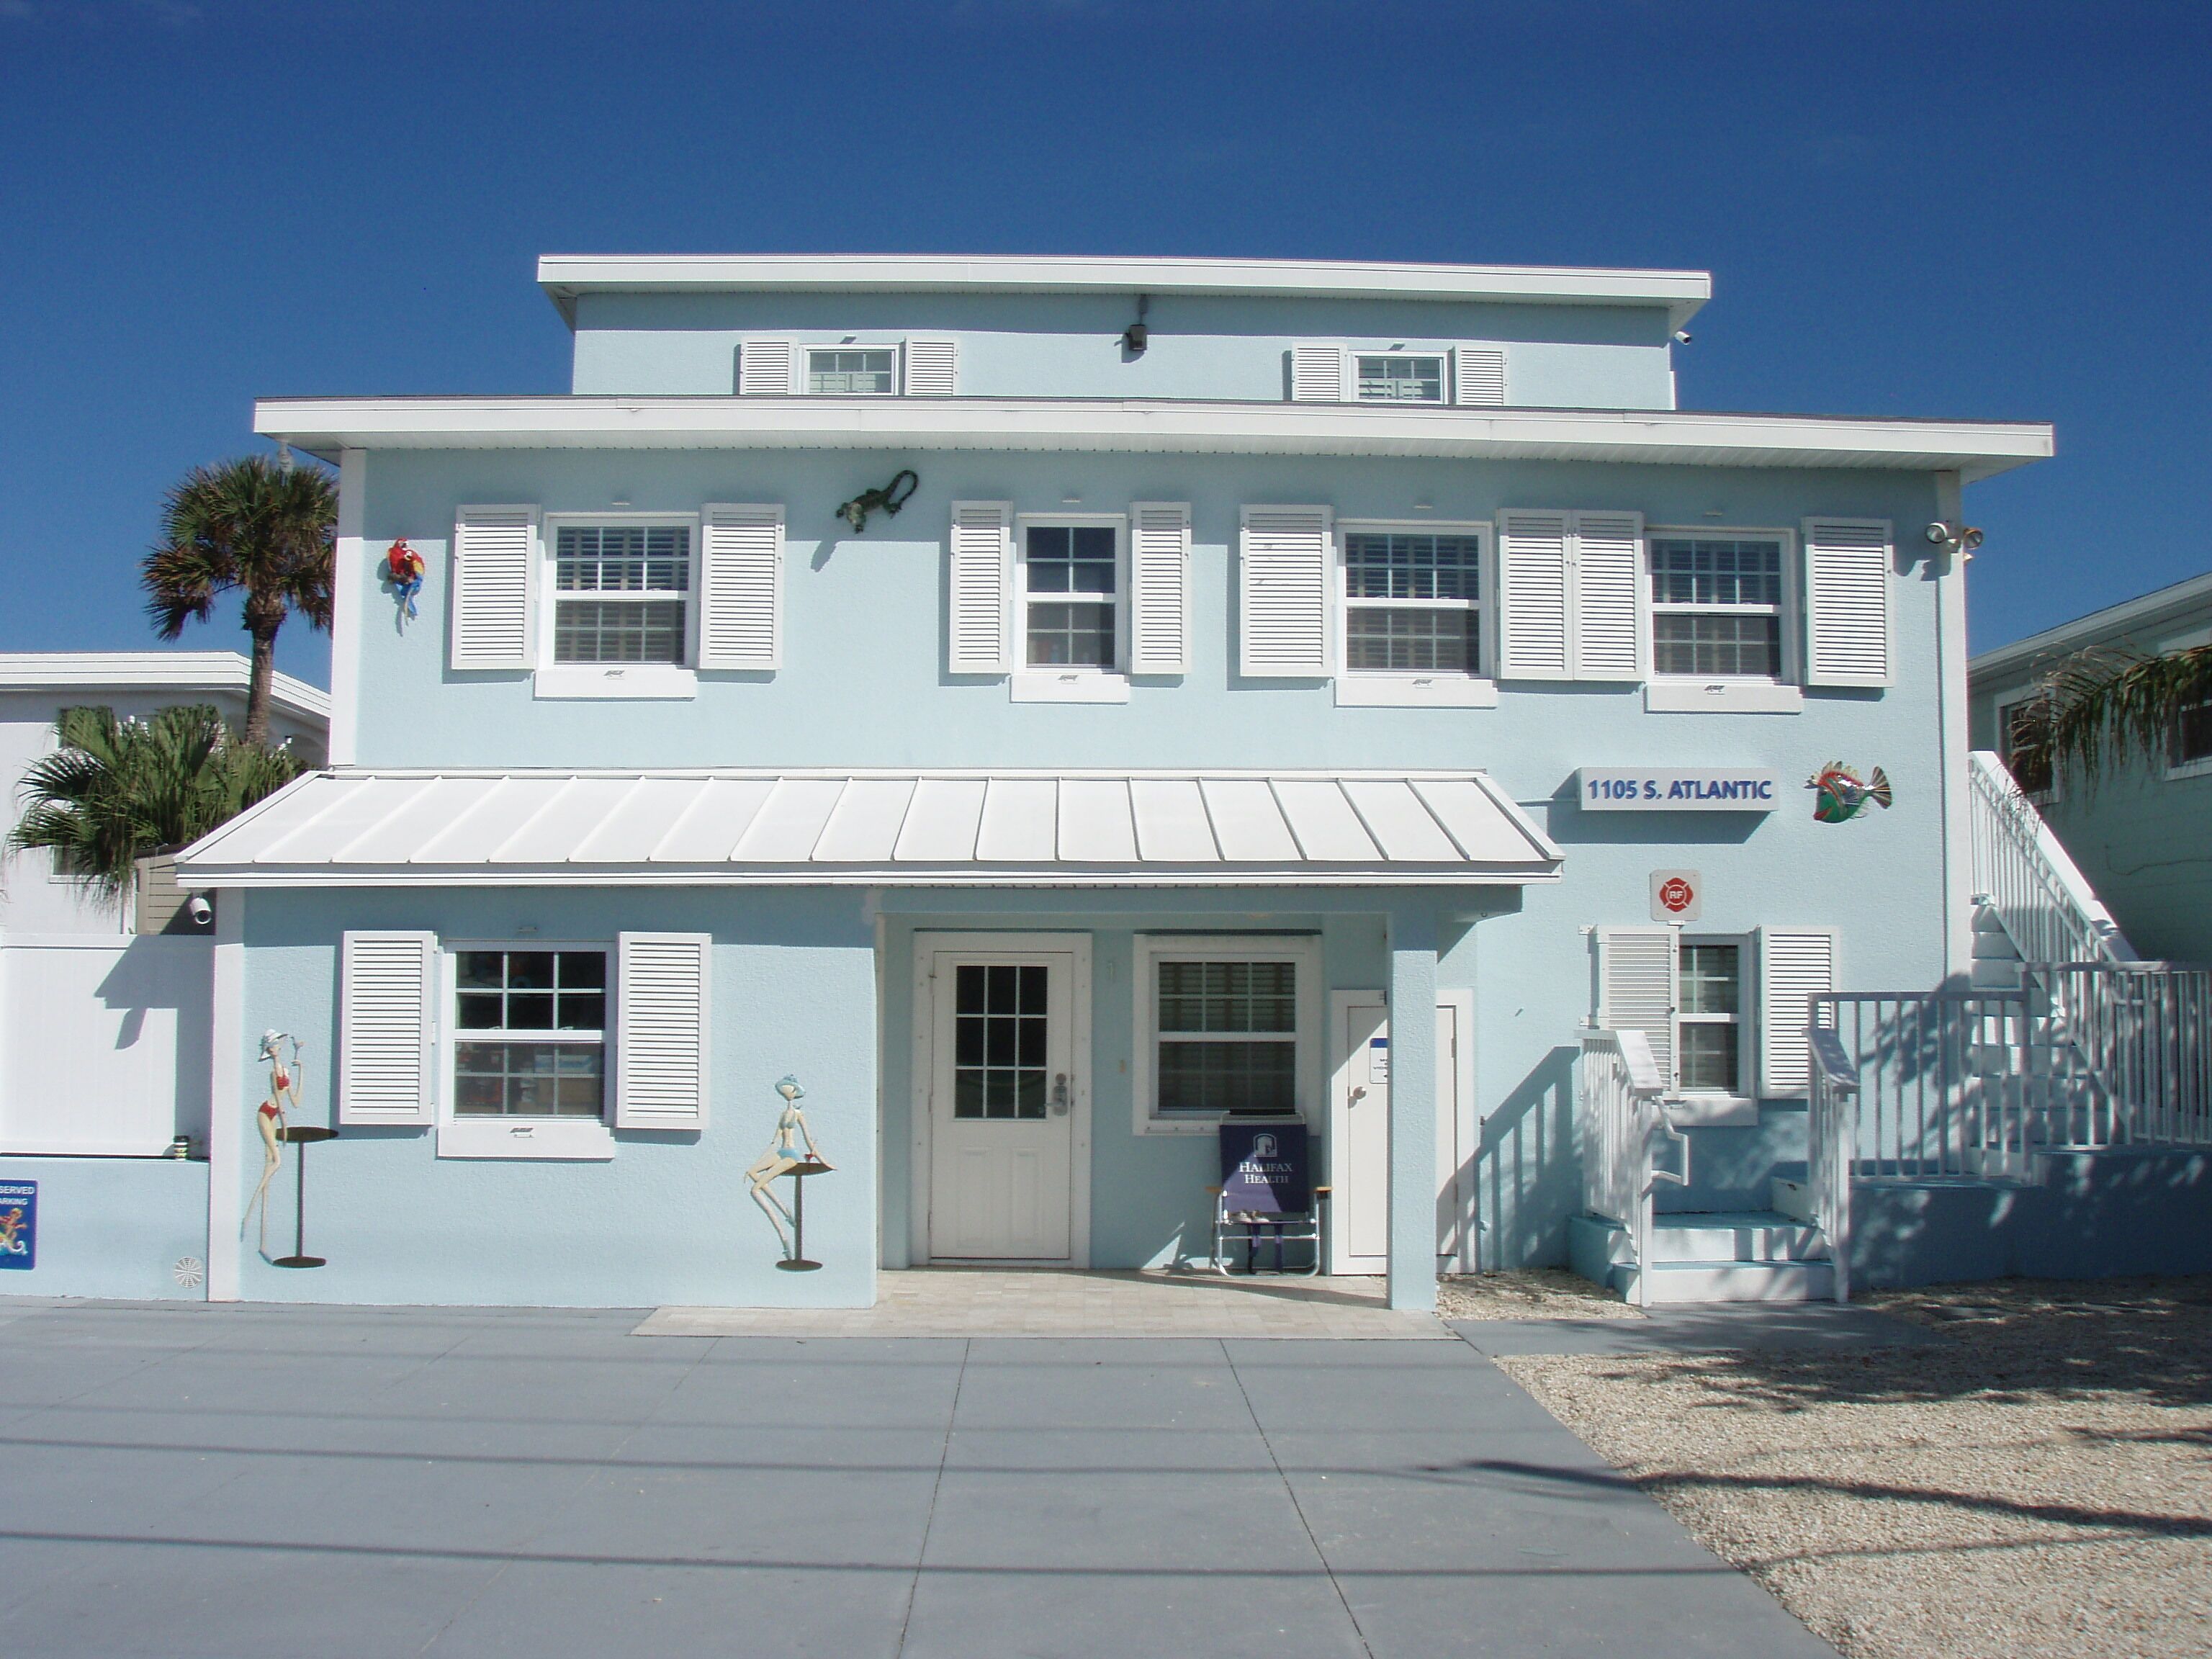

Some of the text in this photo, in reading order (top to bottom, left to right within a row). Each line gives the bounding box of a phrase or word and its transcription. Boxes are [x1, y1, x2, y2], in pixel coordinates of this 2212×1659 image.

[1587, 779, 1772, 800] 1105 S. ATLANTIC
